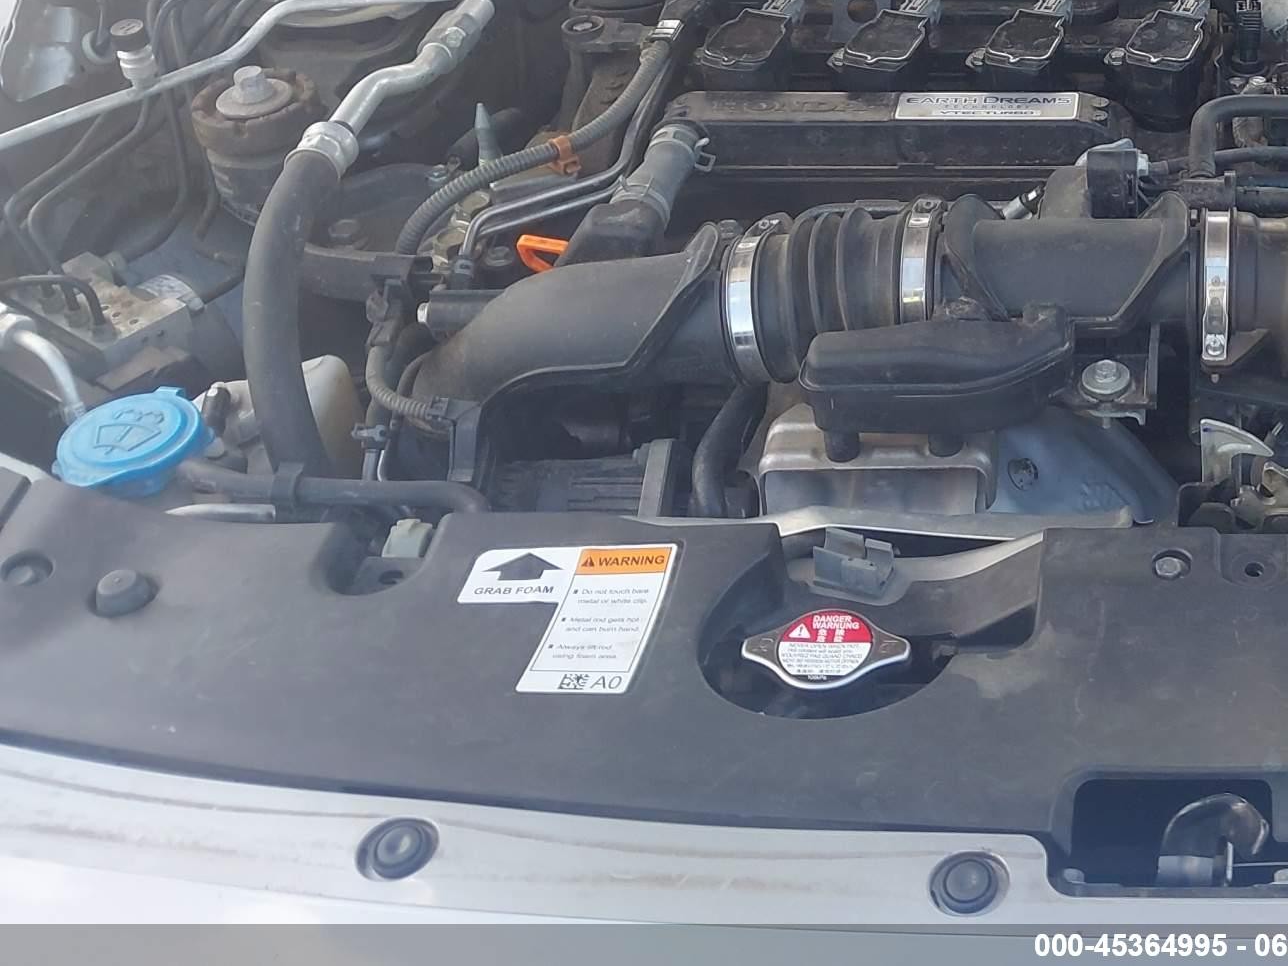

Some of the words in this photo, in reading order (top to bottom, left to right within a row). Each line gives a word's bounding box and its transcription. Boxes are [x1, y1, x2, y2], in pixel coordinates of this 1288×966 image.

[983, 96, 1072, 104] DREAMS
[597, 554, 665, 567] WARNING
[474, 586, 512, 595] GRAB
[516, 585, 554, 594] FOAM
